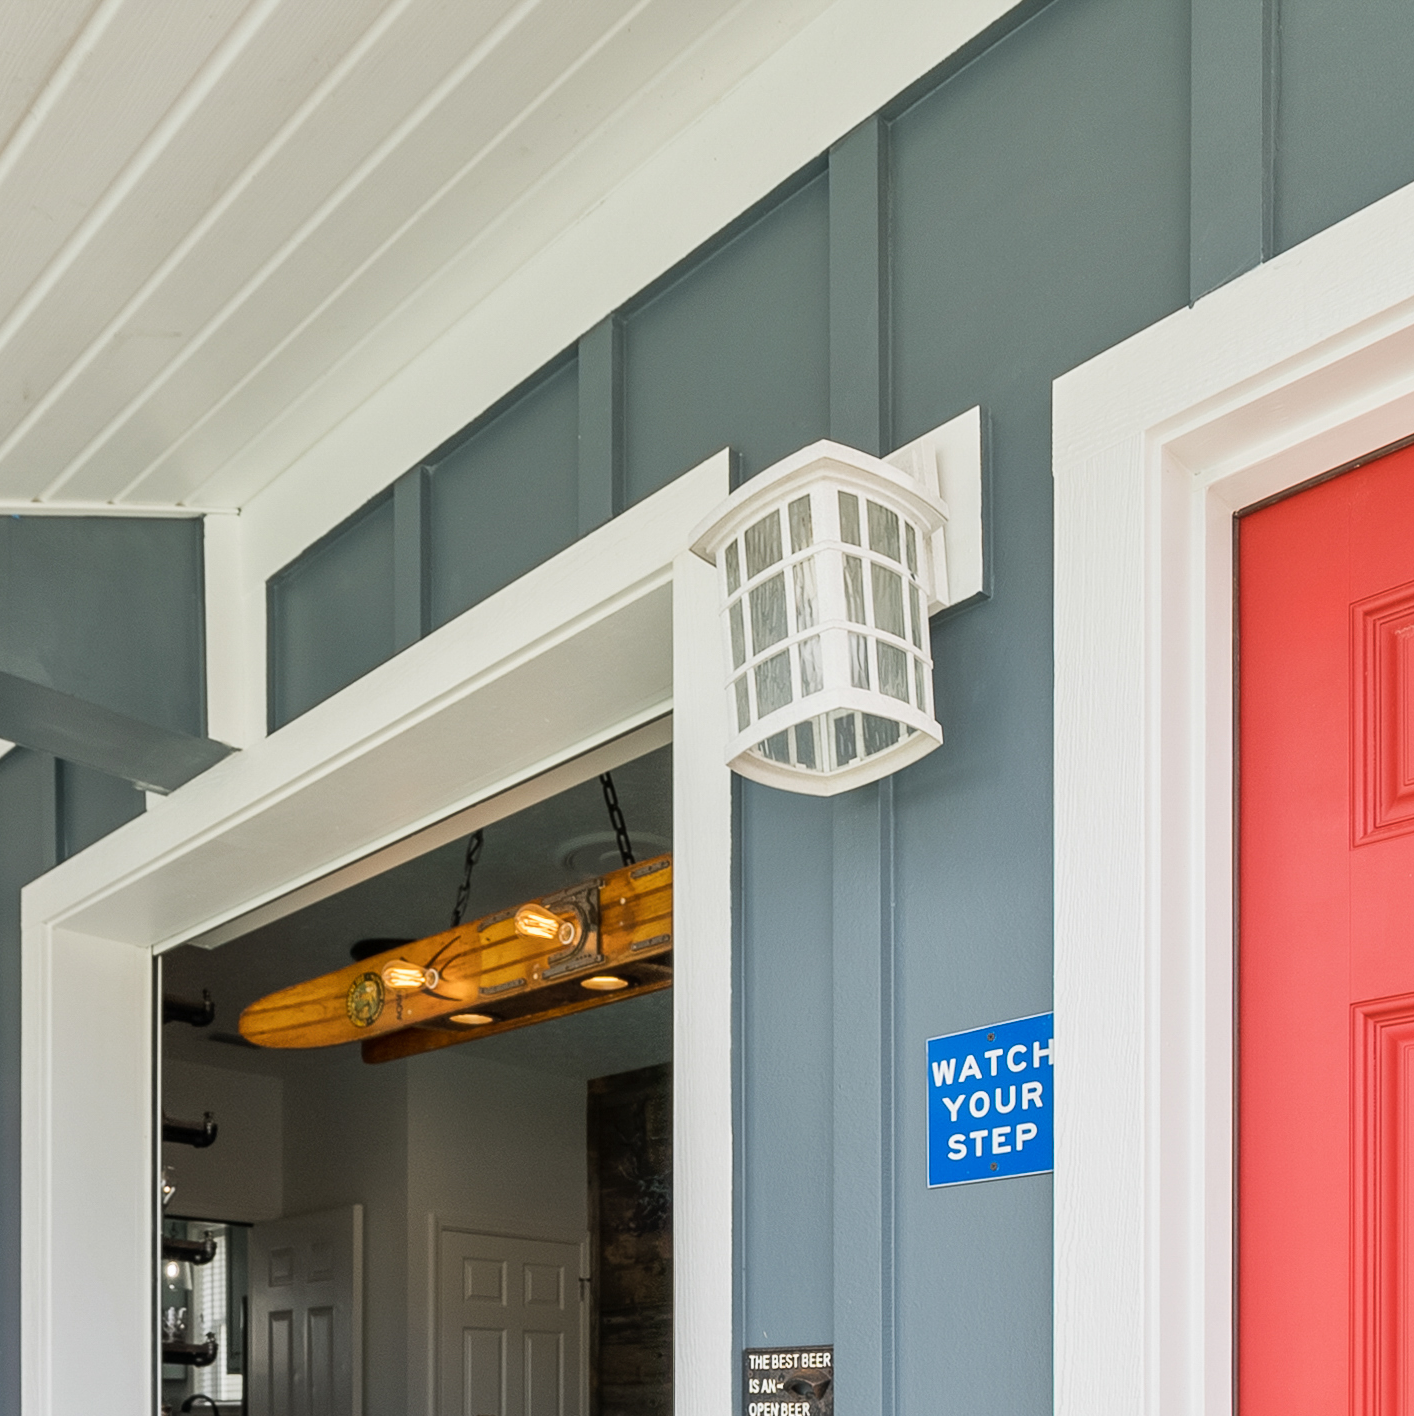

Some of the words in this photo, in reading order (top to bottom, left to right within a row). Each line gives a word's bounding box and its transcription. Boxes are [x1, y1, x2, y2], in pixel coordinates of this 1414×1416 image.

[931, 1038, 1054, 1087] WATCH
[942, 1081, 1043, 1122] YOUR
[947, 1122, 1038, 1161] STEP
[749, 1354, 770, 1370] THE
[771, 1353, 800, 1369] BEST
[801, 1352, 831, 1368] BEER
[749, 1379, 760, 1394] IS
